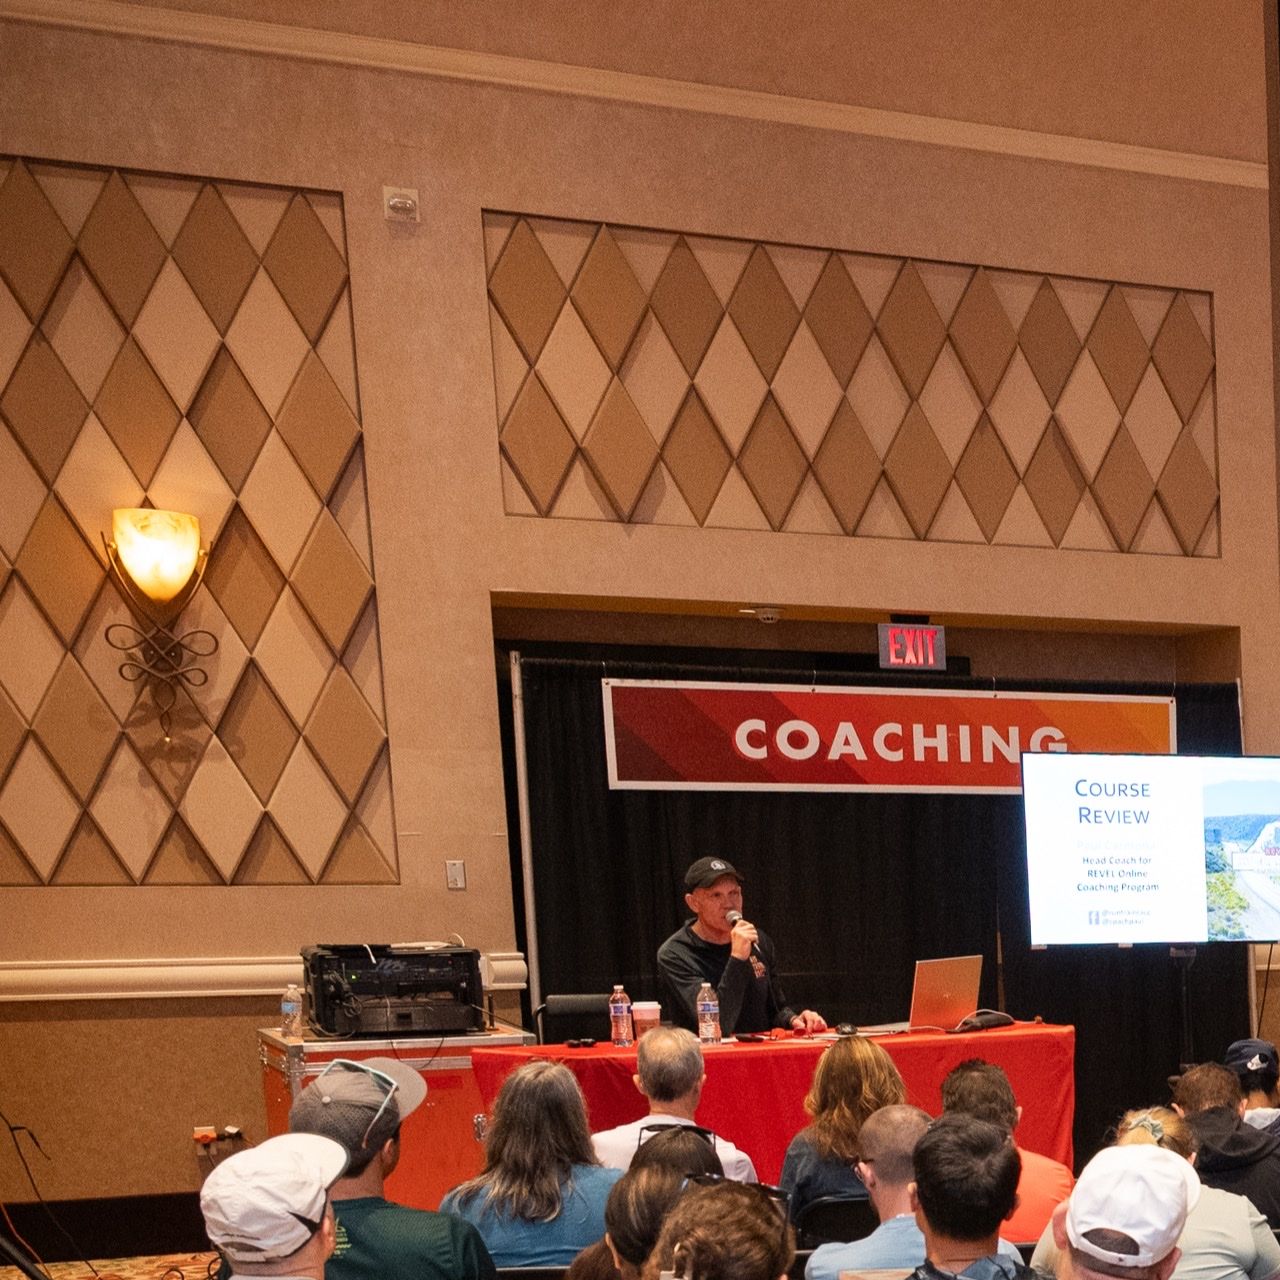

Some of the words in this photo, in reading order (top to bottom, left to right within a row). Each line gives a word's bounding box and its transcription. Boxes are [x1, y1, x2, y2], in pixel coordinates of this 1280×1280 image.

[889, 628, 938, 666] EXIT
[734, 718, 1068, 763] COACHING
[1082, 856, 1106, 864] Head
[1109, 856, 1136, 864] Coach
[1139, 856, 1152, 864] for
[1087, 869, 1115, 878] REVEL
[1118, 869, 1148, 878] Online
[1077, 883, 1118, 892] Coaching
[1121, 883, 1159, 892] Program
